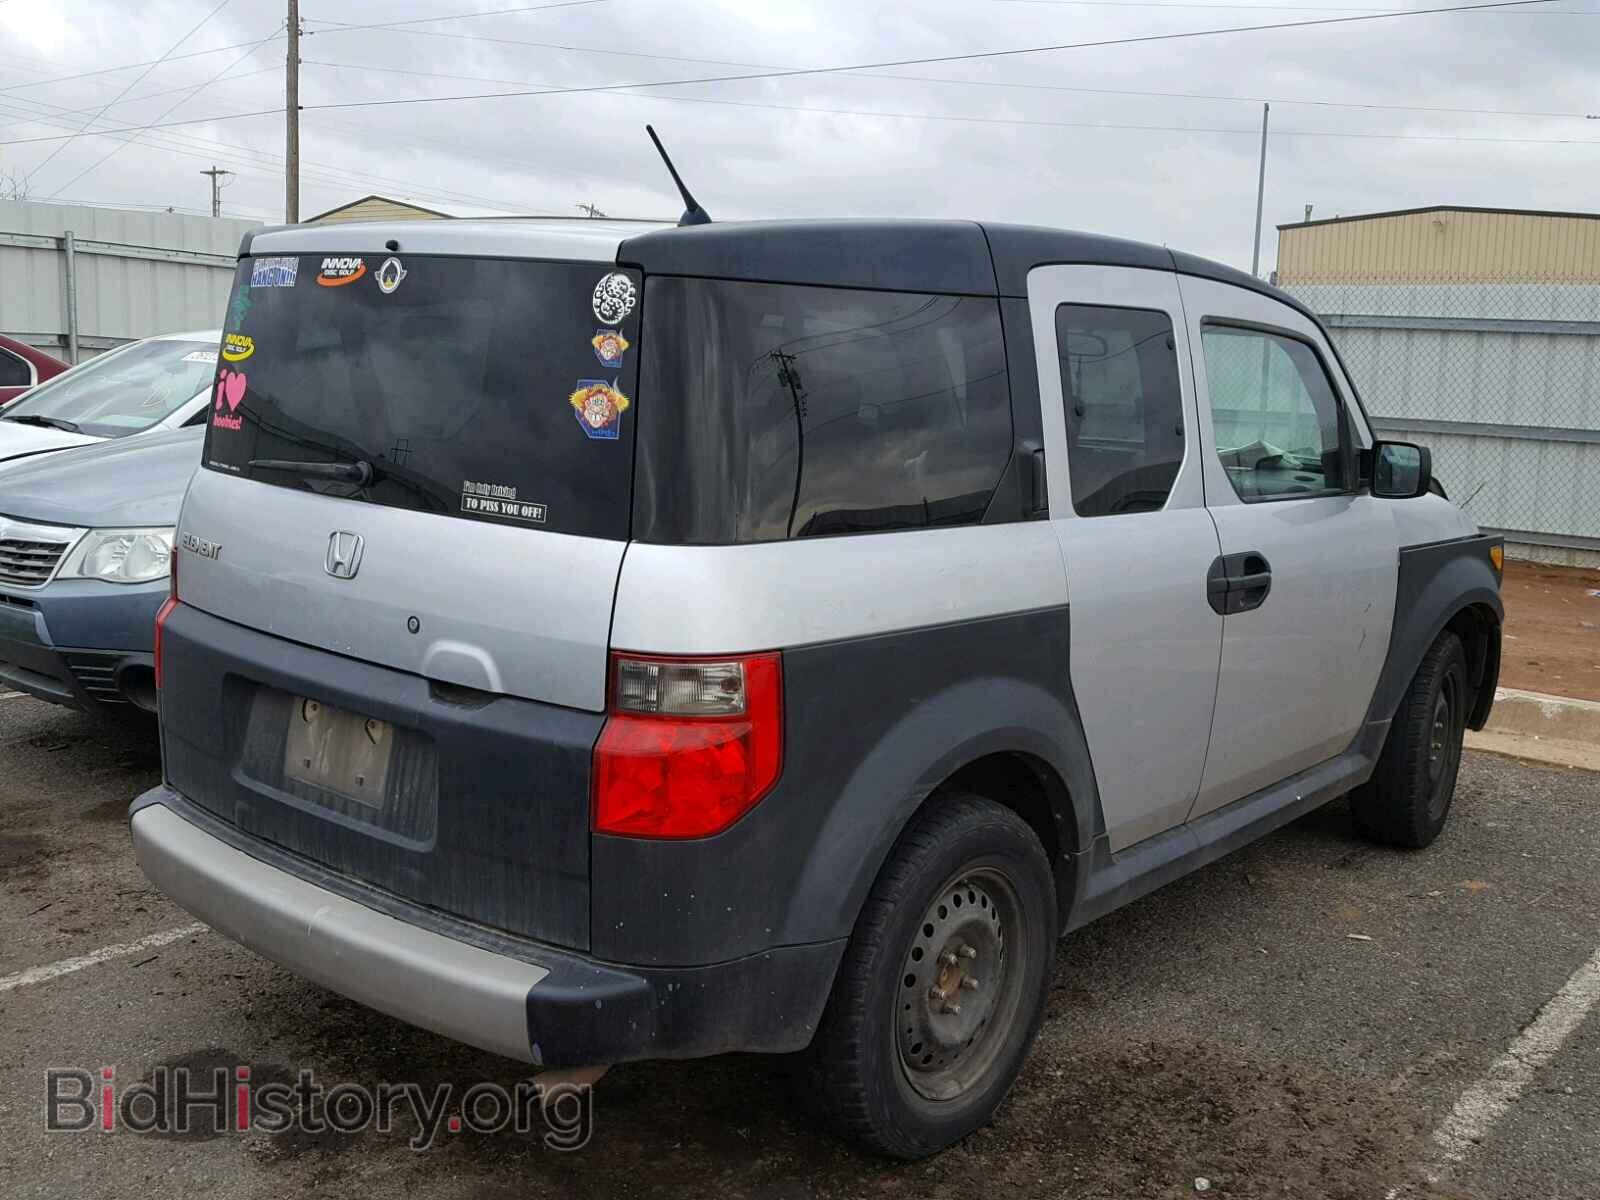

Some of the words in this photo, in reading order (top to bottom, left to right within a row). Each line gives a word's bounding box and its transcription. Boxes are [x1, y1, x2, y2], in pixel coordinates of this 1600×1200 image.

[321, 257, 362, 269] INNOVA
[225, 333, 251, 347] INNOVA
[466, 497, 478, 509] TO
[479, 499, 499, 512] PISS
[501, 502, 519, 516] YOU
[521, 505, 542, 519] OFF!
[183, 531, 222, 559] ELEMENT
